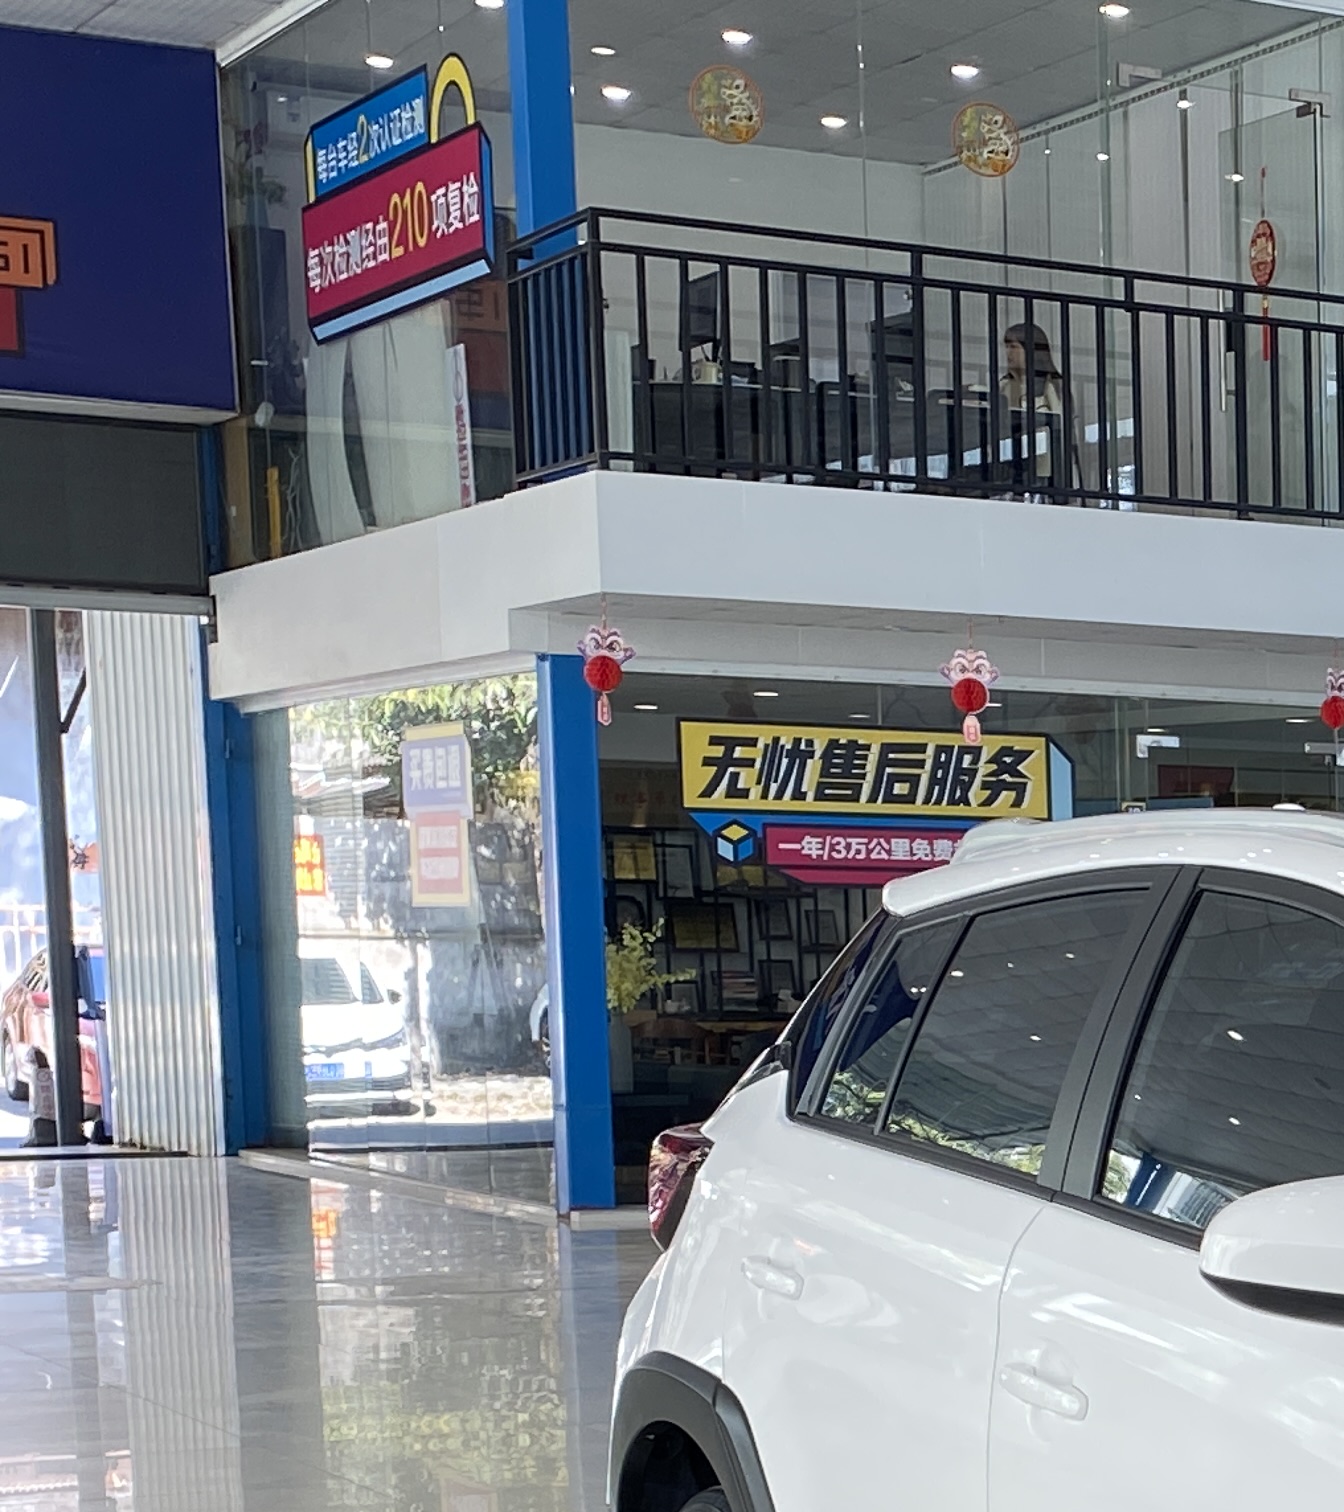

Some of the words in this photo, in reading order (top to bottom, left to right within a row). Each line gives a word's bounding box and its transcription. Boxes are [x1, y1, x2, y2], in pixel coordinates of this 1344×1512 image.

[316, 95, 425, 184] 每台车经2次认证检测
[307, 172, 481, 293] 每次检测经由210项复检
[696, 735, 1041, 809] 无忧售后服务
